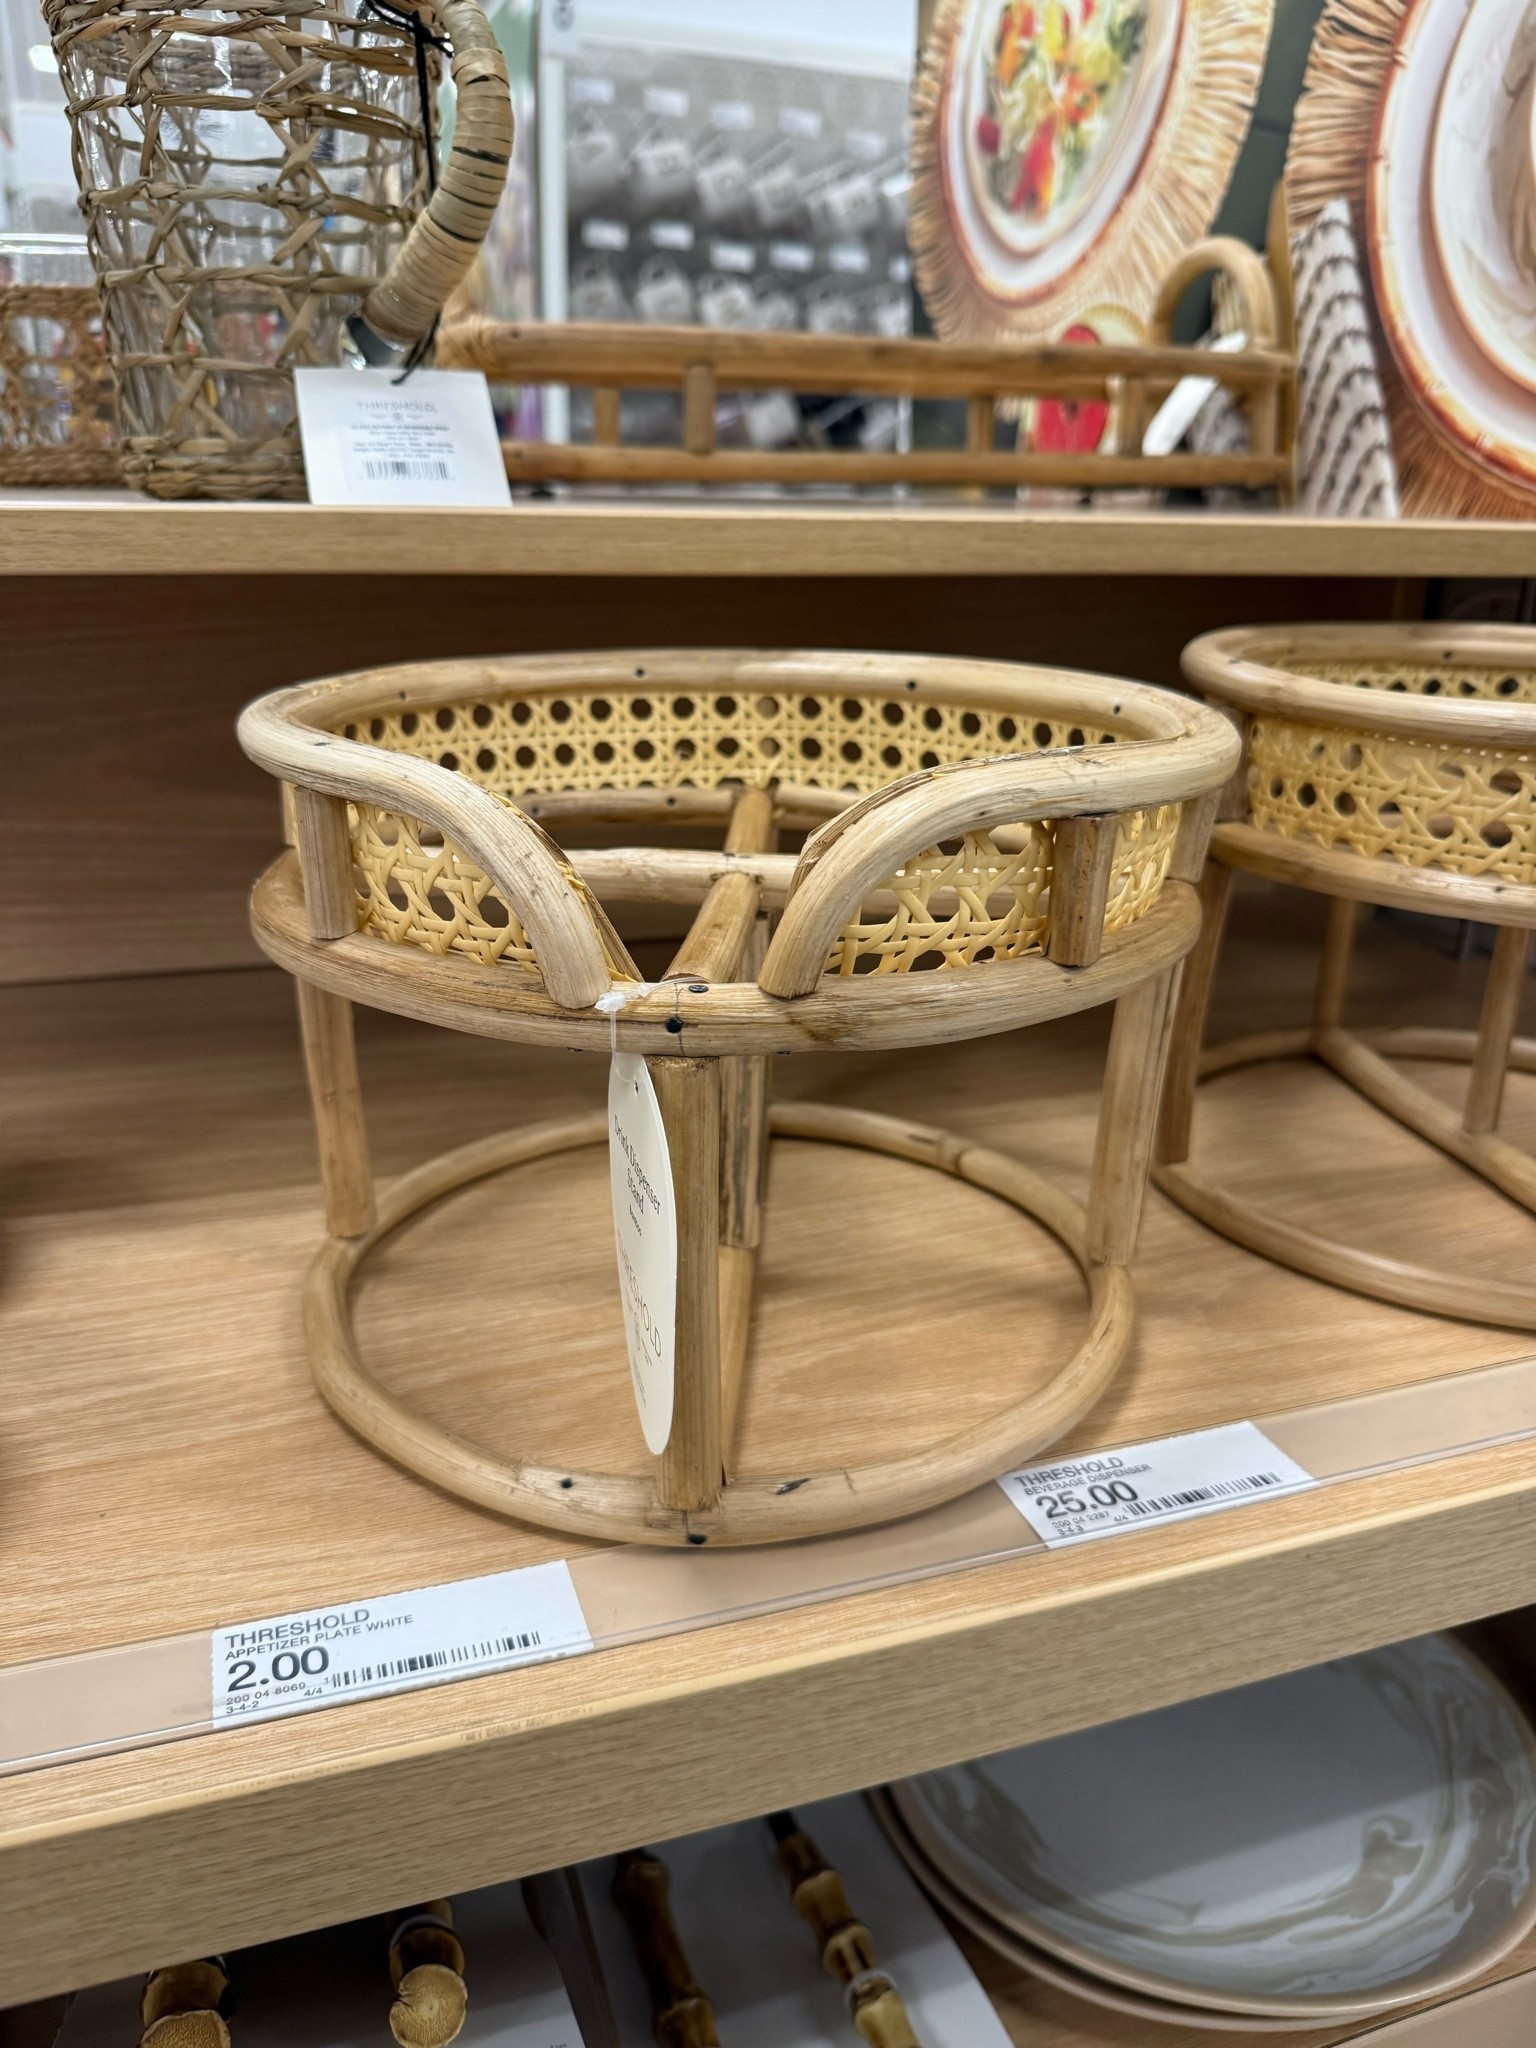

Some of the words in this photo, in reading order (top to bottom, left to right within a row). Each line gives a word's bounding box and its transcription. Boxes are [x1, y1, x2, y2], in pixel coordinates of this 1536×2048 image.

[614, 1114, 630, 1159] Drink
[629, 1144, 661, 1216] Dispenser
[627, 1167, 644, 1215] Stand
[1014, 1457, 1123, 1487] THRESHOLD
[1024, 1476, 1085, 1496] BEVERAGE
[1088, 1463, 1152, 1484] DISPENSER
[1036, 1480, 1138, 1519] 25.00
[225, 1609, 370, 1649] THRESHOLD
[225, 1636, 310, 1660] APPETIZER
[315, 1625, 363, 1643] PLATE
[367, 1614, 413, 1632] WHITE
[227, 1645, 330, 1692] 2.00
[226, 1694, 250, 1706] 200
[254, 1690, 270, 1700] 04
[274, 1682, 306, 1695] 8069
[226, 1700, 259, 1714] 3-4-2
[303, 1687, 323, 1697] 4/4
